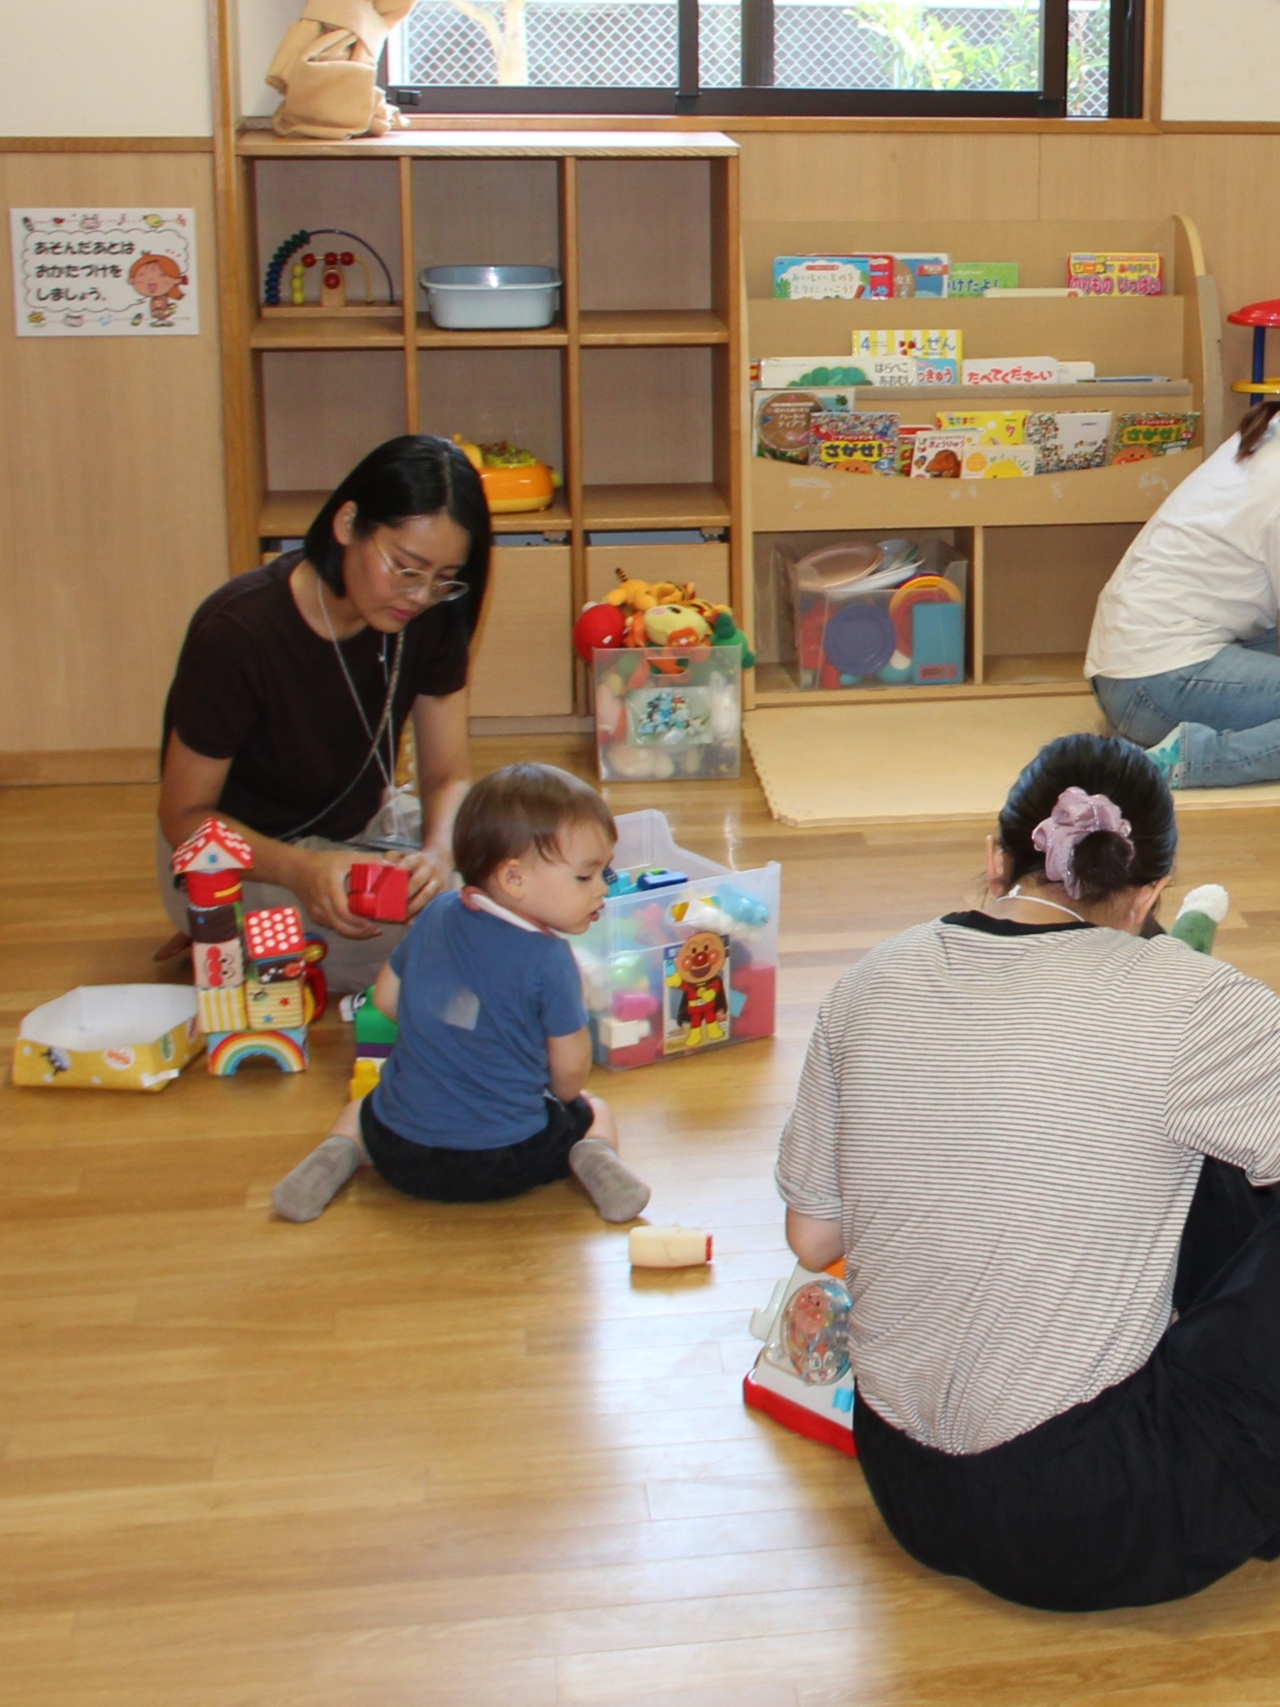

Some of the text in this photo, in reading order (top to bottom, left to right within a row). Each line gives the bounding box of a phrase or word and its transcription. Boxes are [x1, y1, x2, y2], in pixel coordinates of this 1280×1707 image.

[34, 241, 136, 255] あそんだあとは
[35, 264, 123, 278] おかたづけを
[875, 362, 909, 374] はらぺこ
[967, 366, 1053, 384] たべてくださーい
[824, 442, 883, 458] さがせ!
